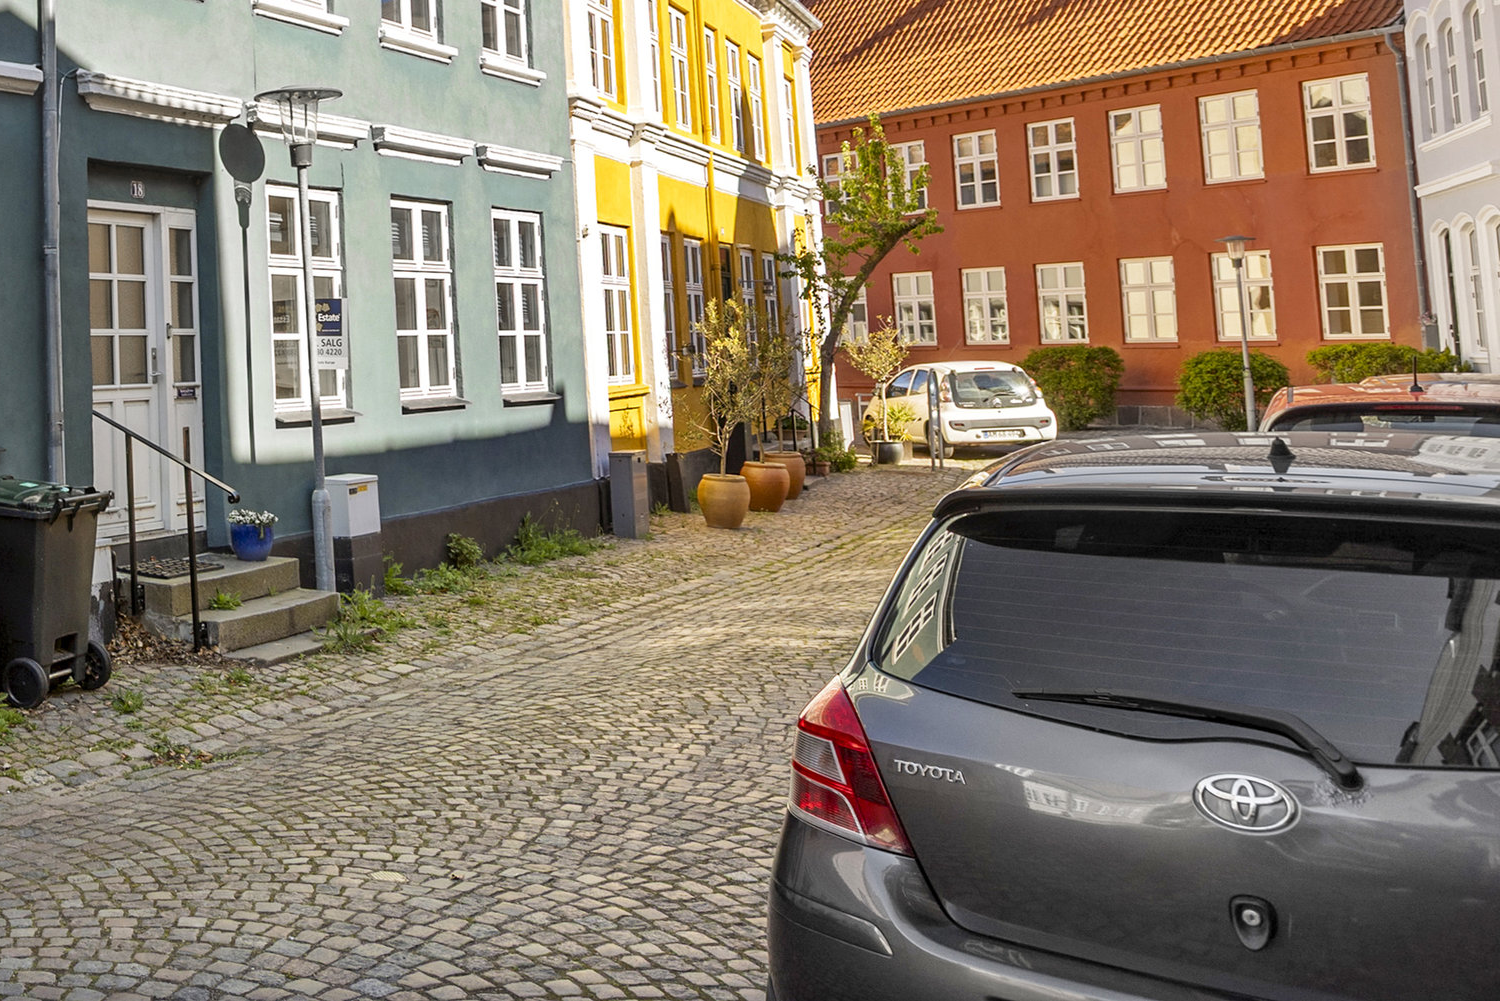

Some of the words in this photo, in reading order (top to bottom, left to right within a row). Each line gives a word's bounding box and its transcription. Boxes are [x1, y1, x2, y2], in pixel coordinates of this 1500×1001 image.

[132, 183, 143, 196] 18
[317, 313, 340, 322] Estate
[320, 338, 343, 347] SALG
[325, 348, 343, 356] 4220
[894, 759, 966, 785] TOYOTA
